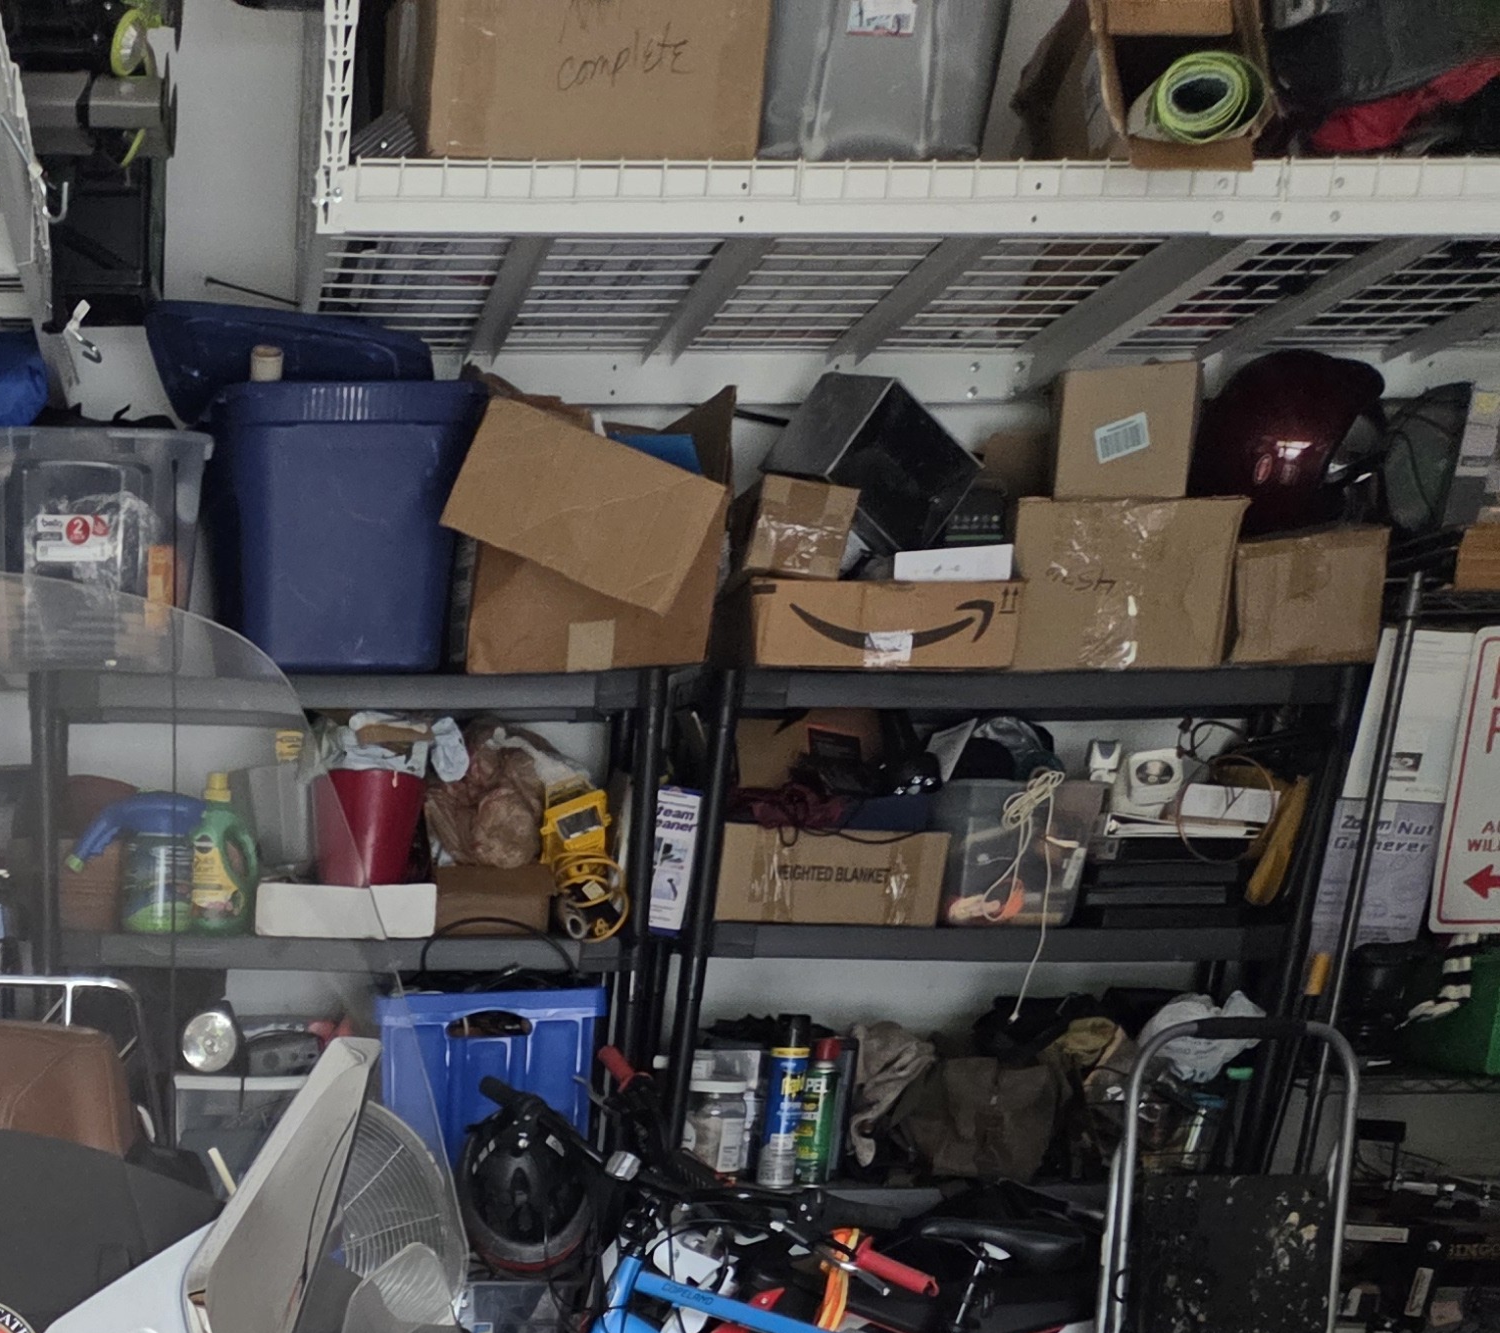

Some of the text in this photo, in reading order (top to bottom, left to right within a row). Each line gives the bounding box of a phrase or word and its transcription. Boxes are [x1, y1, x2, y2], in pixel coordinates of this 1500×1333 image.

[656, 805, 695, 822] team
[655, 818, 699, 833] eaner
[1341, 814, 1392, 831] Zom
[834, 866, 891, 884] BLANKET
[661, 1282, 714, 1306] COPELAND
